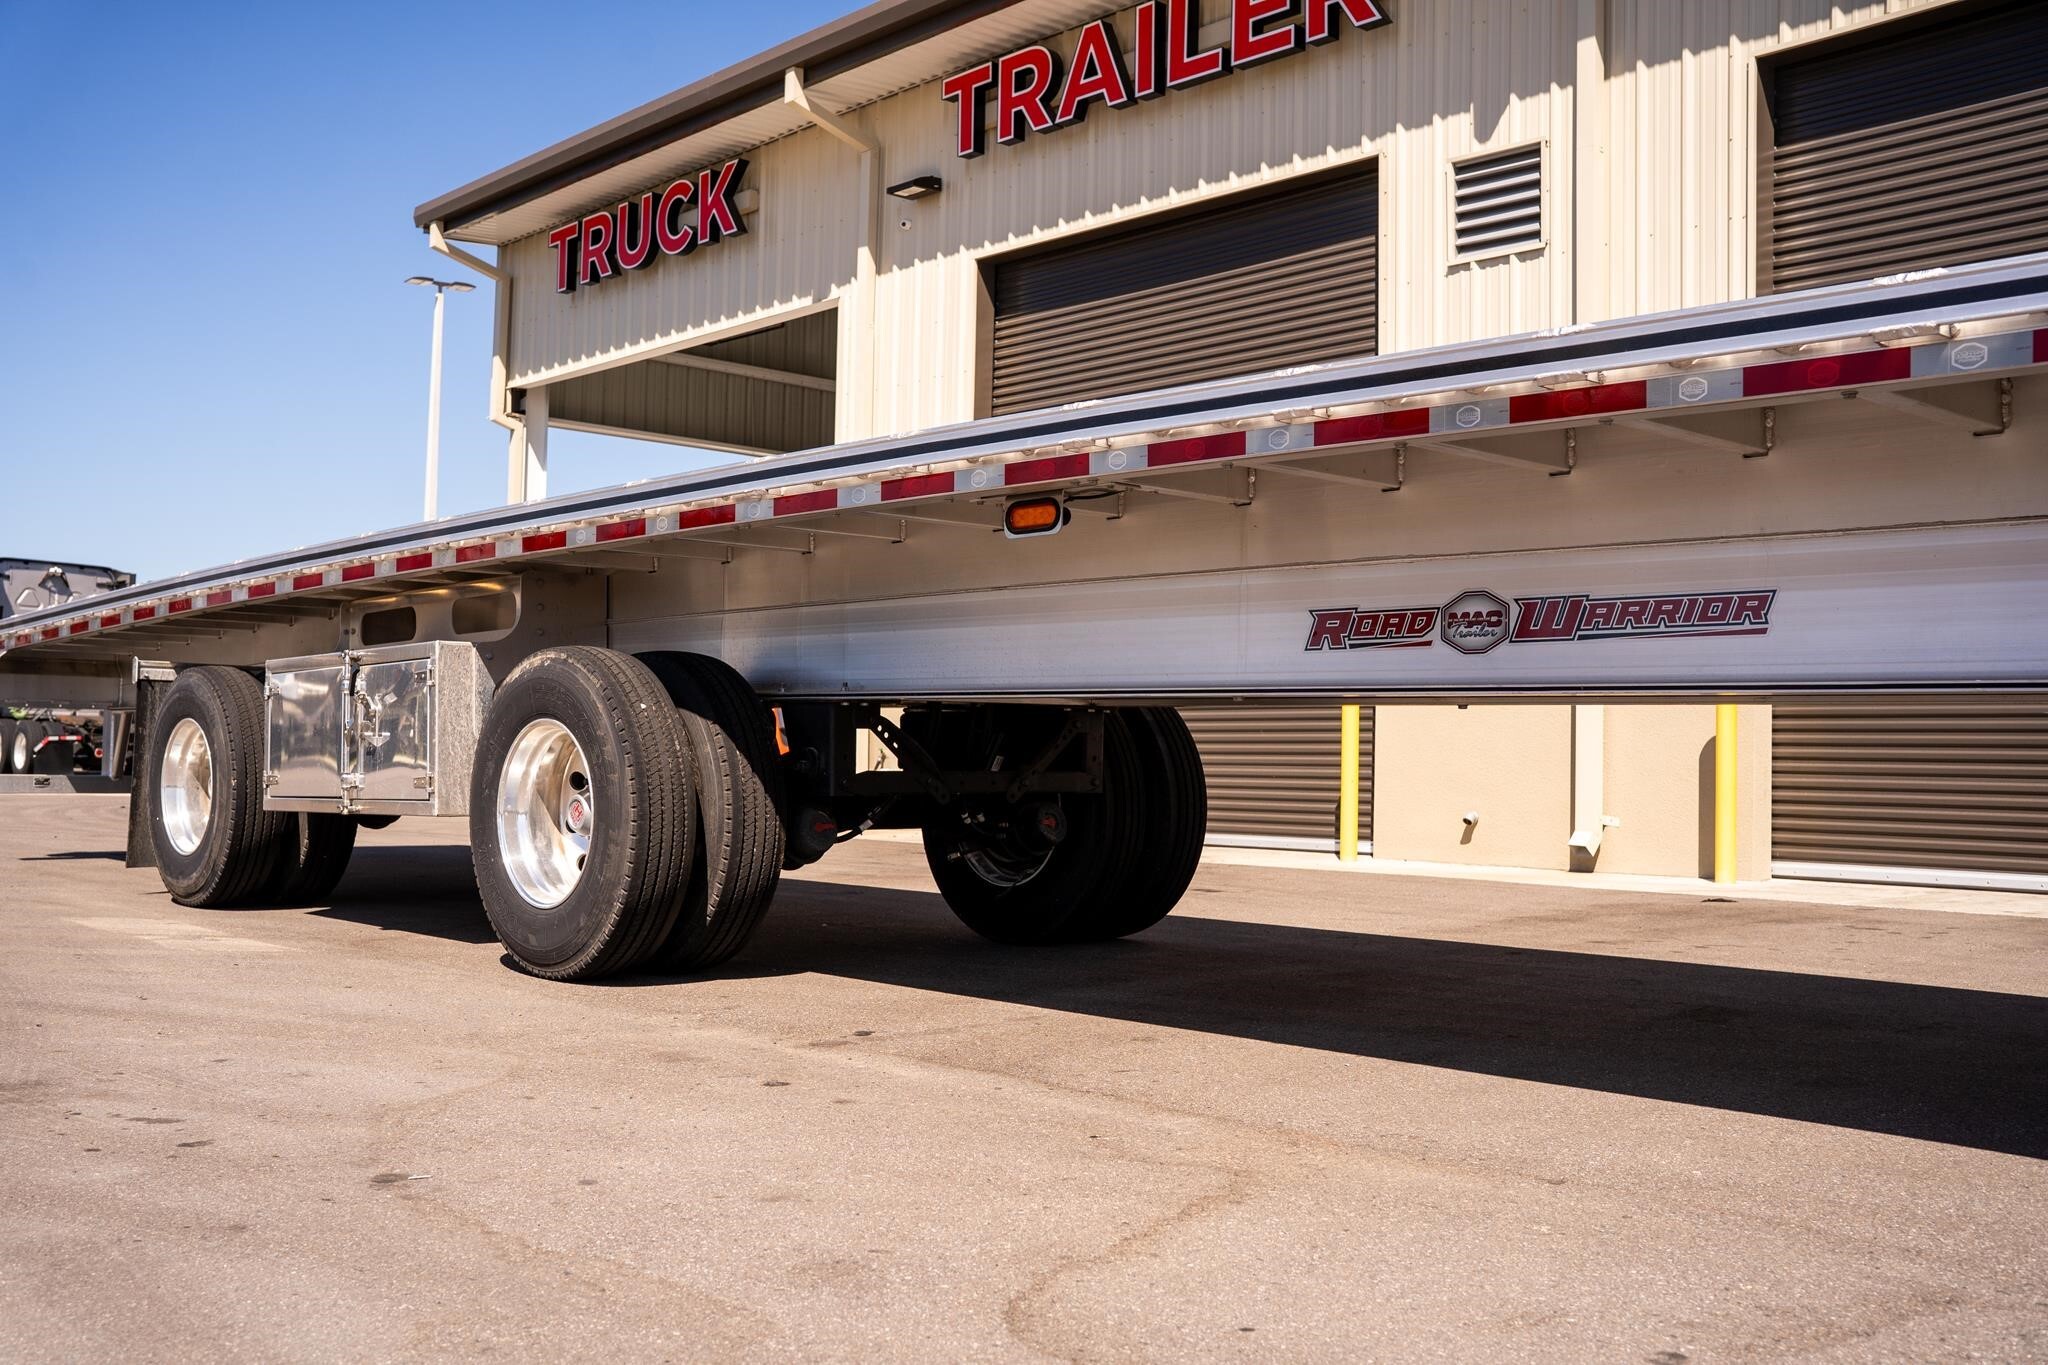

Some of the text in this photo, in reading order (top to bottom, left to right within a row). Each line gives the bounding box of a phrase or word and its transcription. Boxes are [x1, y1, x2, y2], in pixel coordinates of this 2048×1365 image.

[548, 158, 748, 294] TRUCK
[1448, 610, 1503, 629] MAC
[1452, 622, 1497, 638] Trailer
